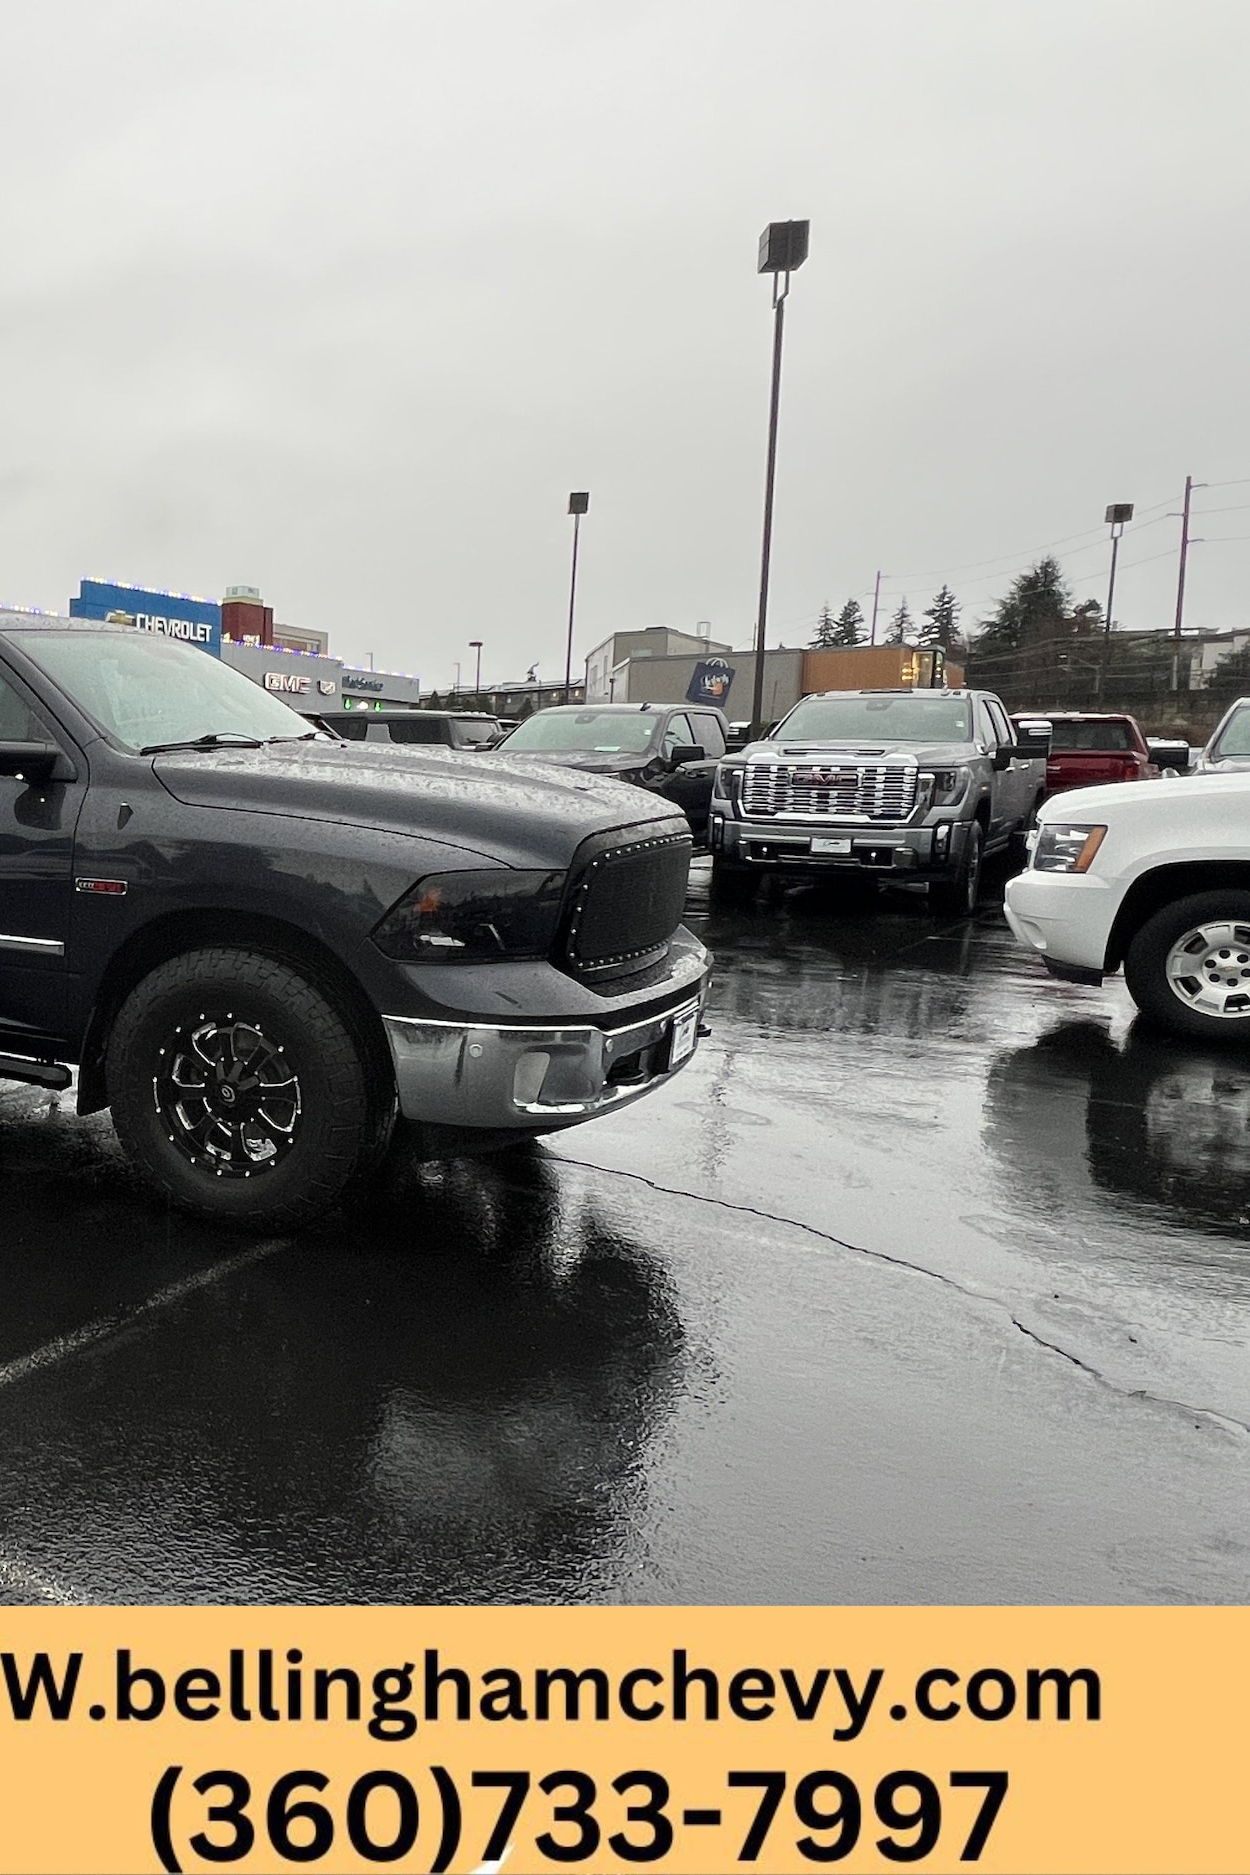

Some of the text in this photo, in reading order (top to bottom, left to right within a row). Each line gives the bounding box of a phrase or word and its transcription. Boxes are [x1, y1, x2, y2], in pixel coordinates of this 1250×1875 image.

[136, 613, 213, 642] CHEVROLET
[264, 672, 312, 694] GMC
[793, 773, 857, 785] GMC
